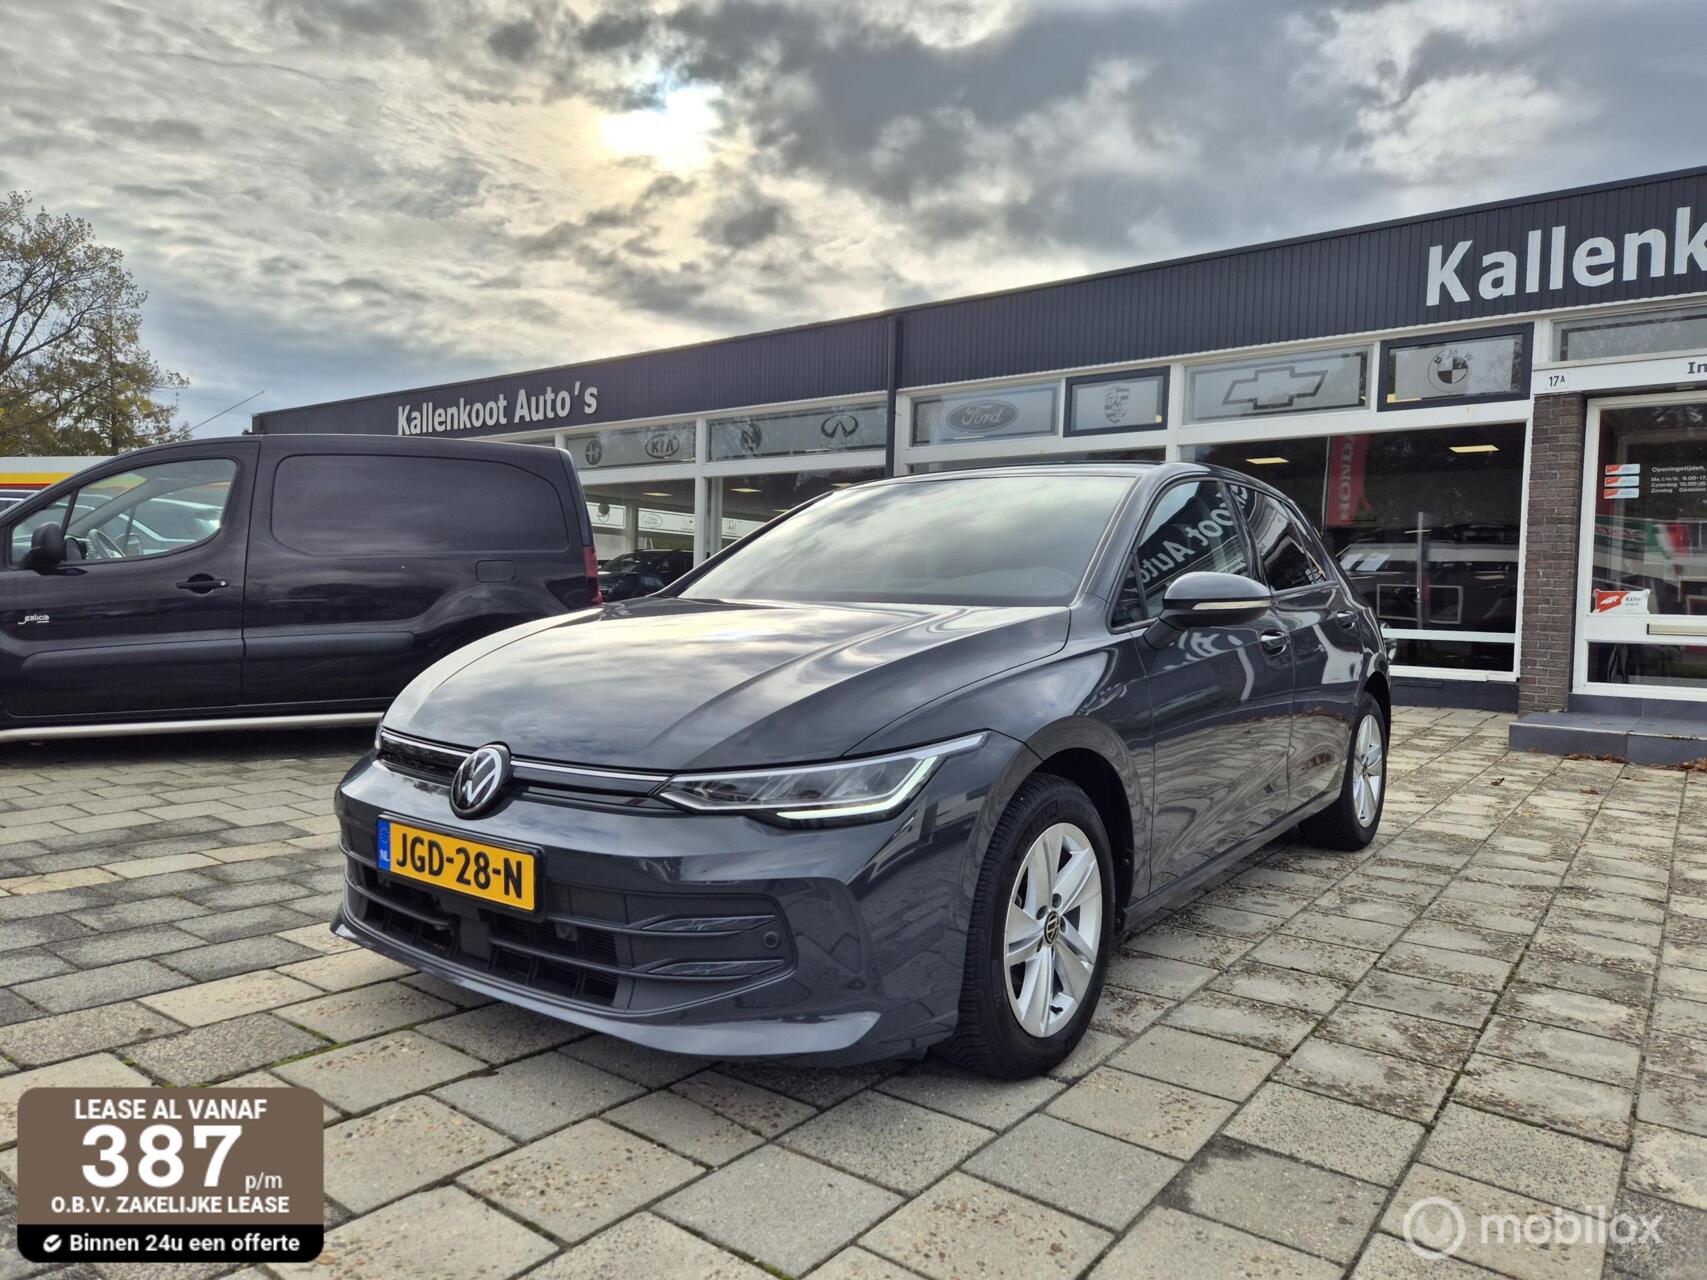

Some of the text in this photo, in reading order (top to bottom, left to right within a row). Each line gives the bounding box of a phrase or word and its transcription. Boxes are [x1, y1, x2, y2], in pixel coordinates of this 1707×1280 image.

[1548, 375, 1566, 387] 17A
[398, 381, 598, 436] Kallenkoot Auto's
[962, 404, 1004, 426] Ford
[651, 439, 675, 454] KIA
[379, 849, 390, 862] NL
[396, 833, 522, 899] JGD-28-N
